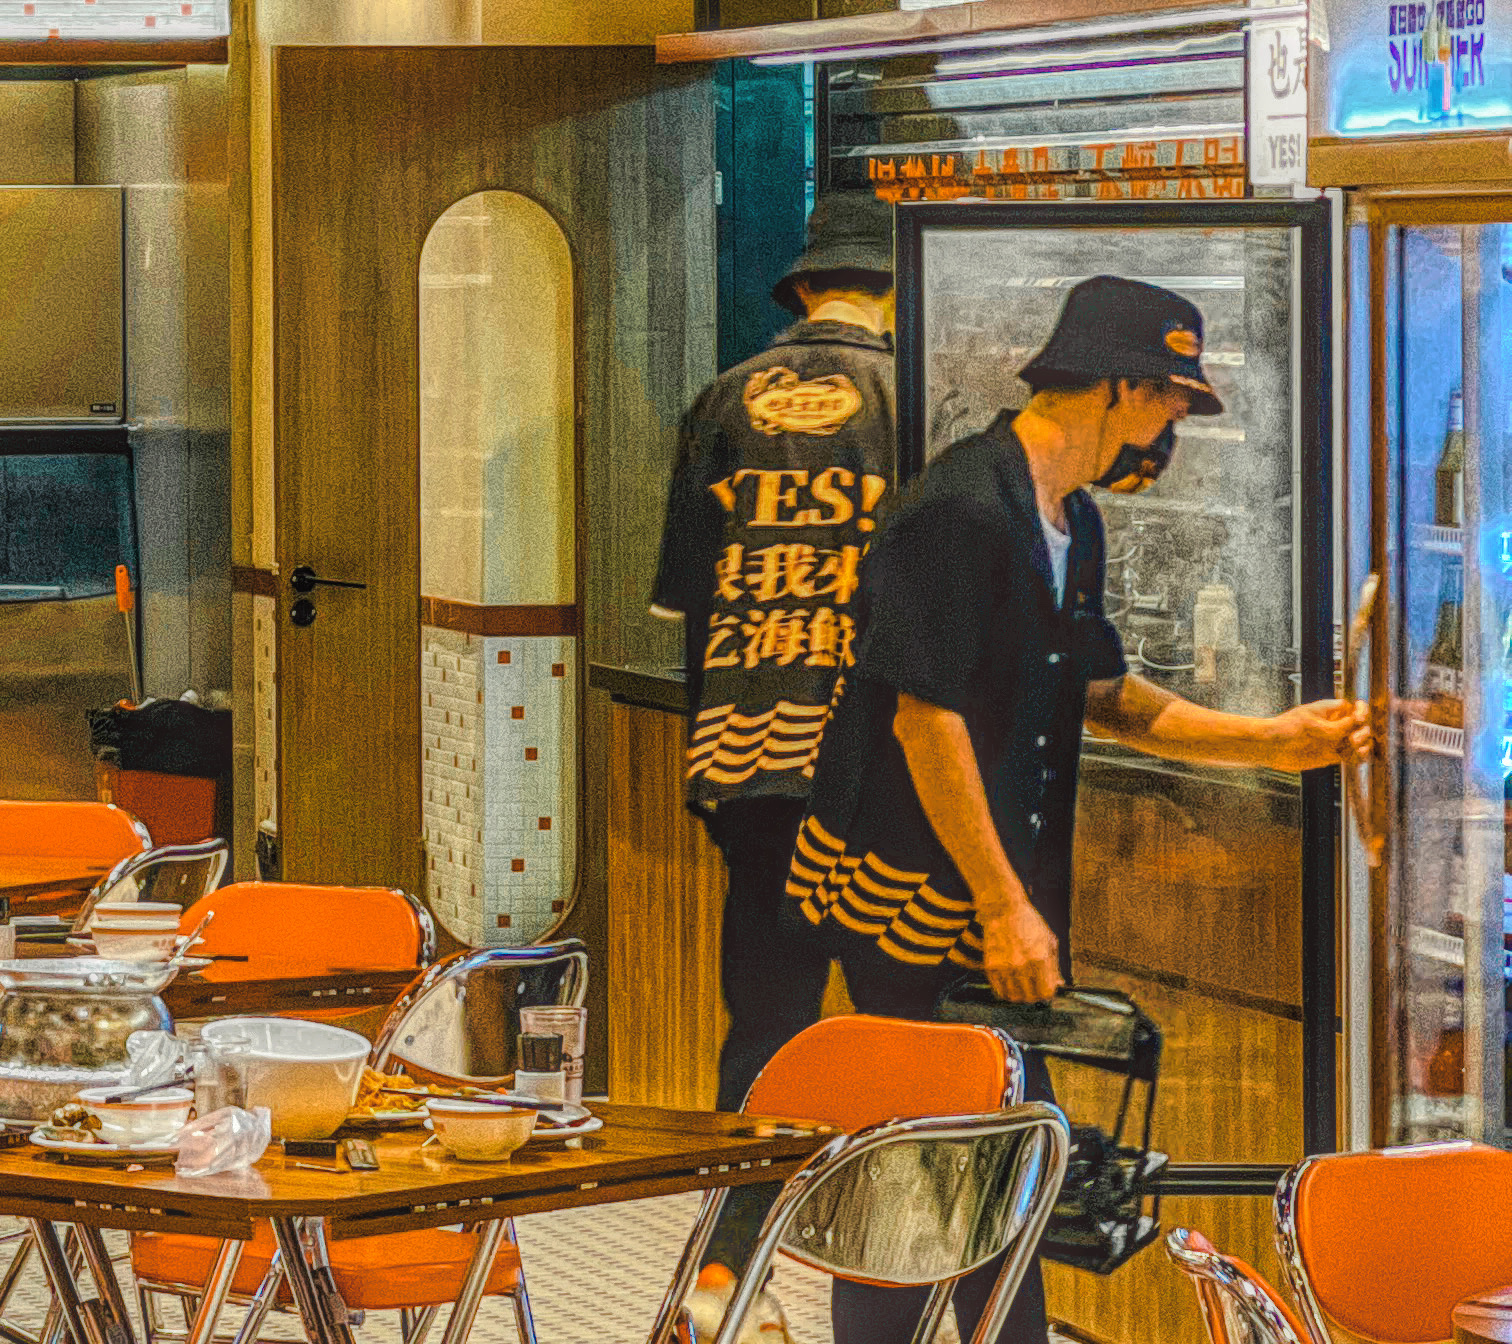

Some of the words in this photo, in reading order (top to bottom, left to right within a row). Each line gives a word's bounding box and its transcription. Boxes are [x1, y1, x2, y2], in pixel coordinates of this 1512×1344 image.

[1388, 33, 1485, 94] SUMER
[1268, 133, 1301, 169] YES!
[708, 467, 887, 533] YES!
